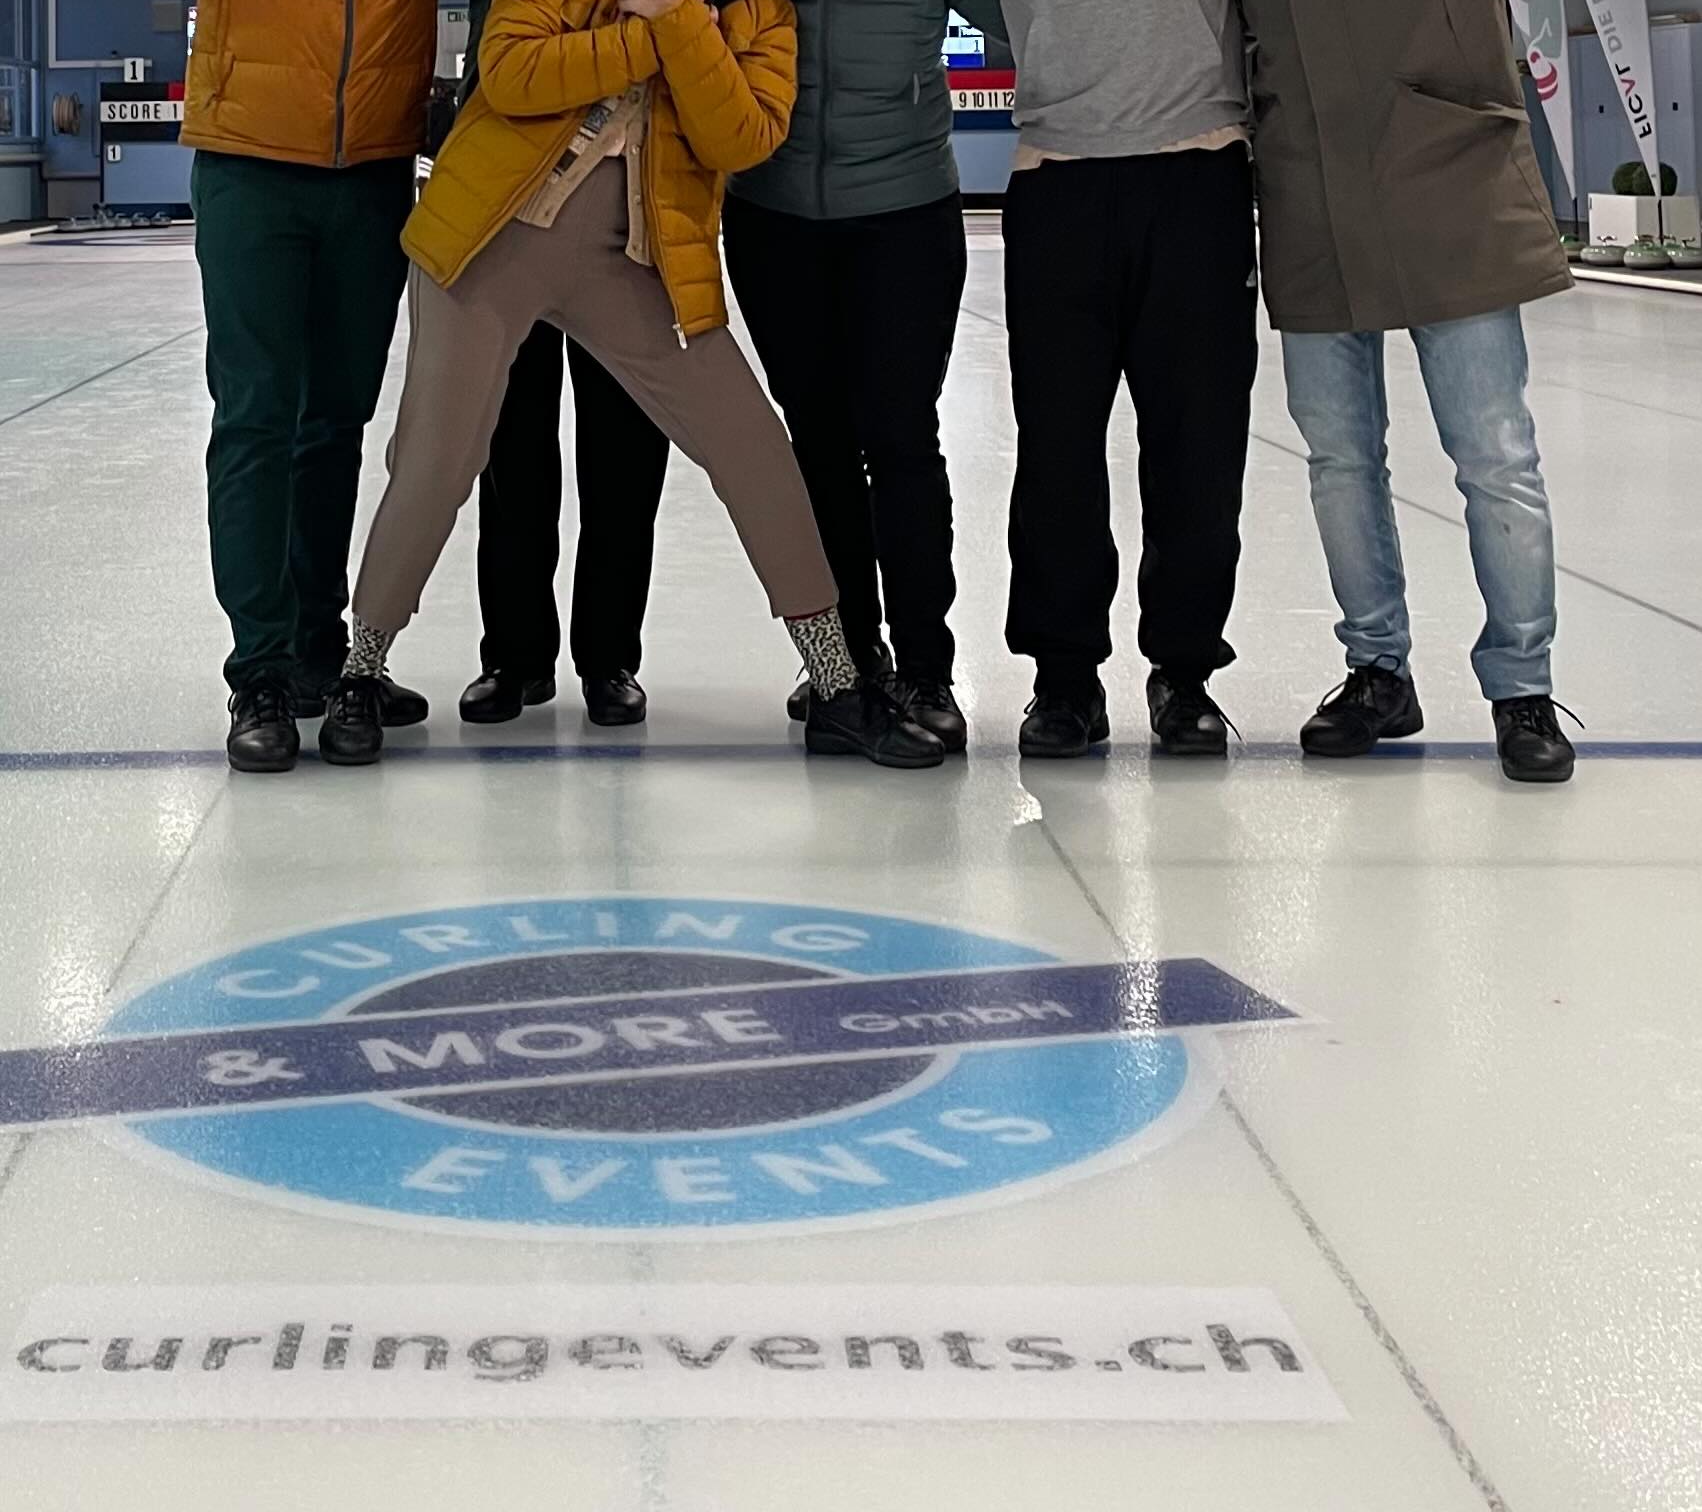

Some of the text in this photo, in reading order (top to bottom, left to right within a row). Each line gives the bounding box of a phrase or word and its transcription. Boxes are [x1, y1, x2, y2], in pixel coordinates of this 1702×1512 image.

[130, 60, 138, 80] 1
[959, 92, 1014, 107] 9 10 11 12
[107, 103, 161, 119] SCORE
[216, 910, 870, 999] CURLING
[204, 999, 1074, 1085] & MORE GmbH
[402, 1107, 1054, 1204] EVENTS
[15, 1321, 1304, 1382] curlingevents.ch
